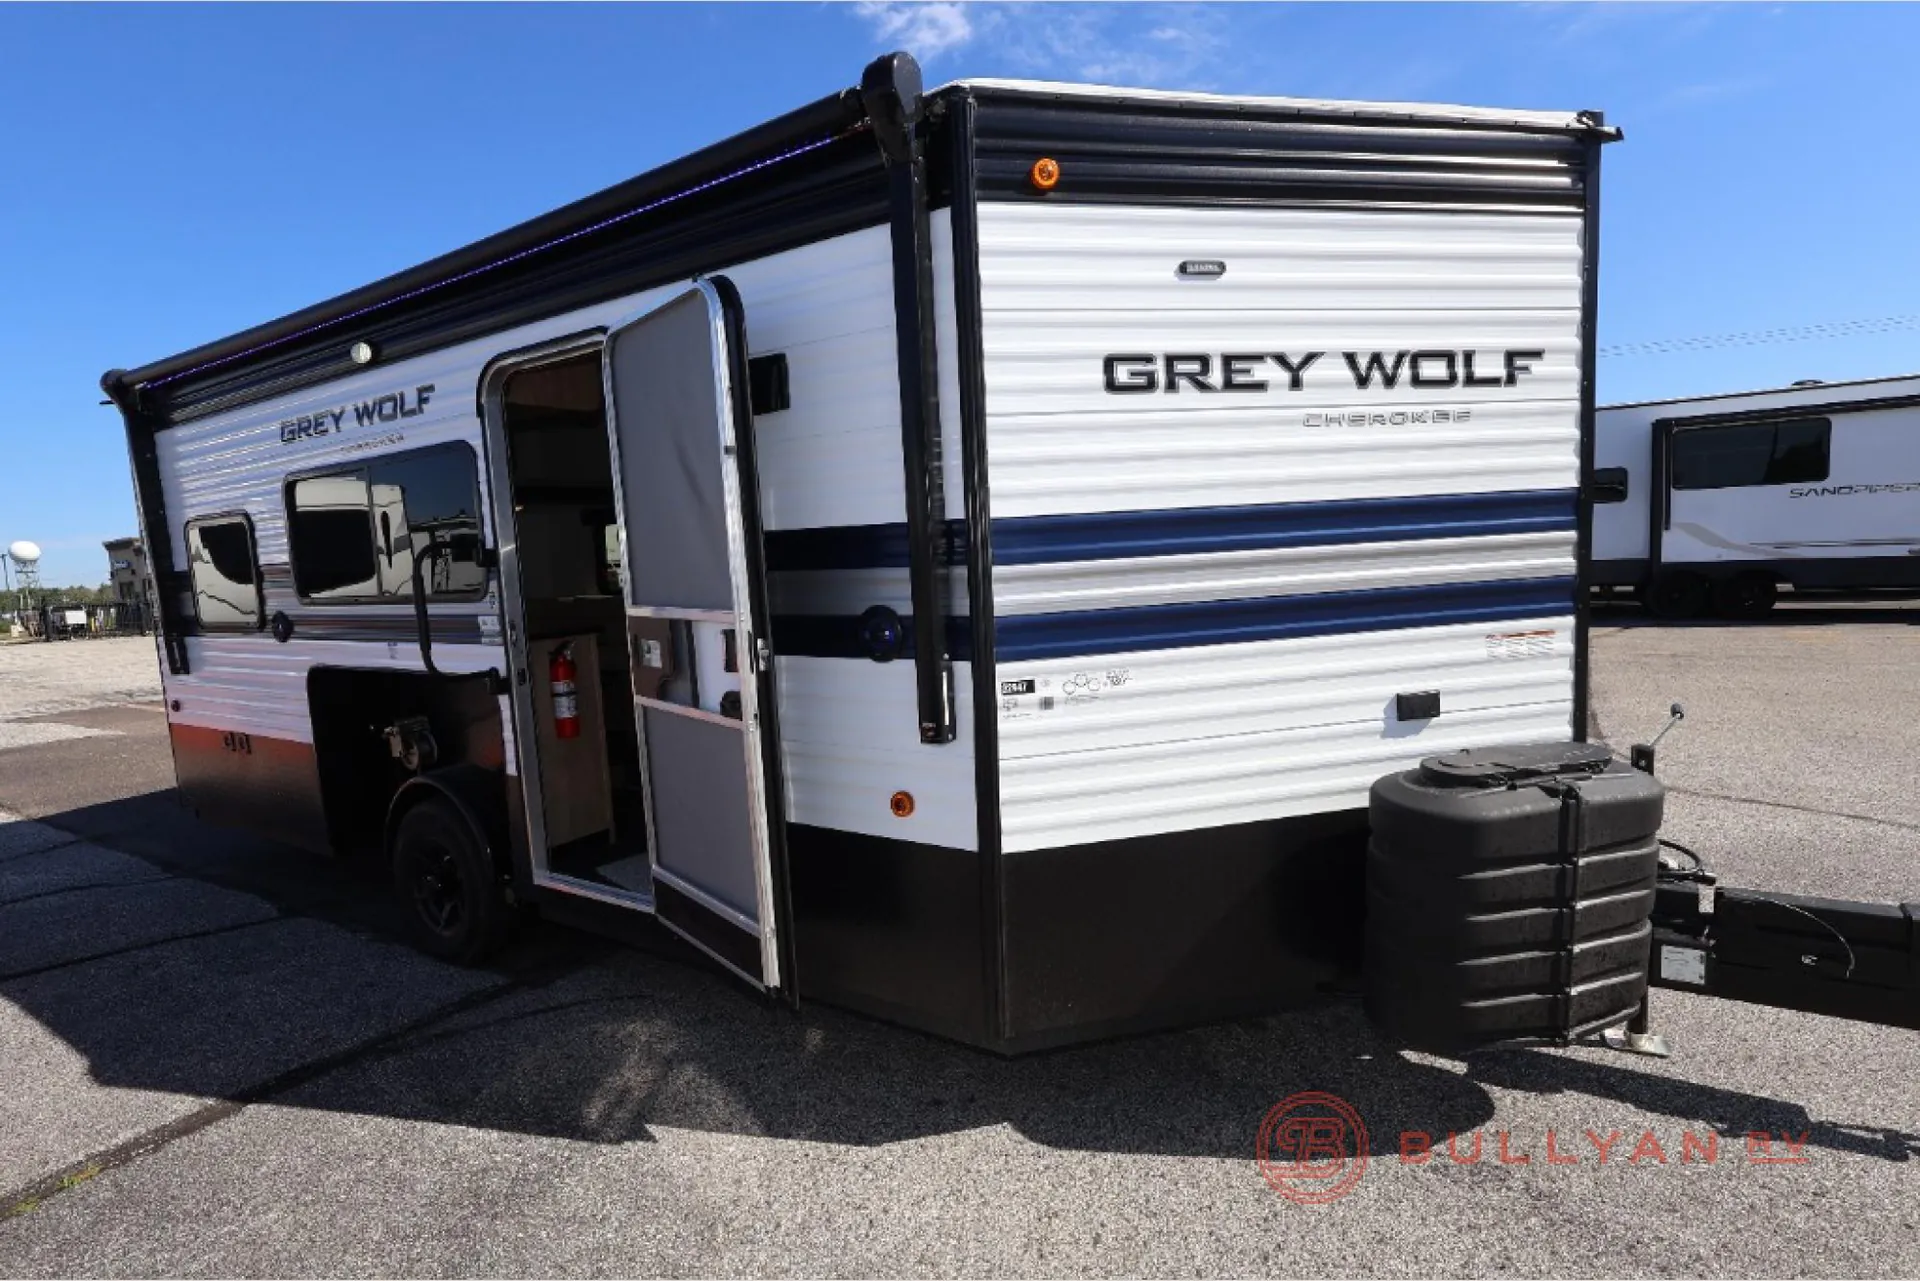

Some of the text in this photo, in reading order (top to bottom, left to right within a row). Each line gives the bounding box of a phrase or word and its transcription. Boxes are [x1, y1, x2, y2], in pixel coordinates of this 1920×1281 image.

[1103, 348, 1546, 394] GREY WOLF
[280, 406, 346, 443] GREY
[353, 383, 436, 428] WOLF
[1302, 409, 1471, 428] CHEROKEE
